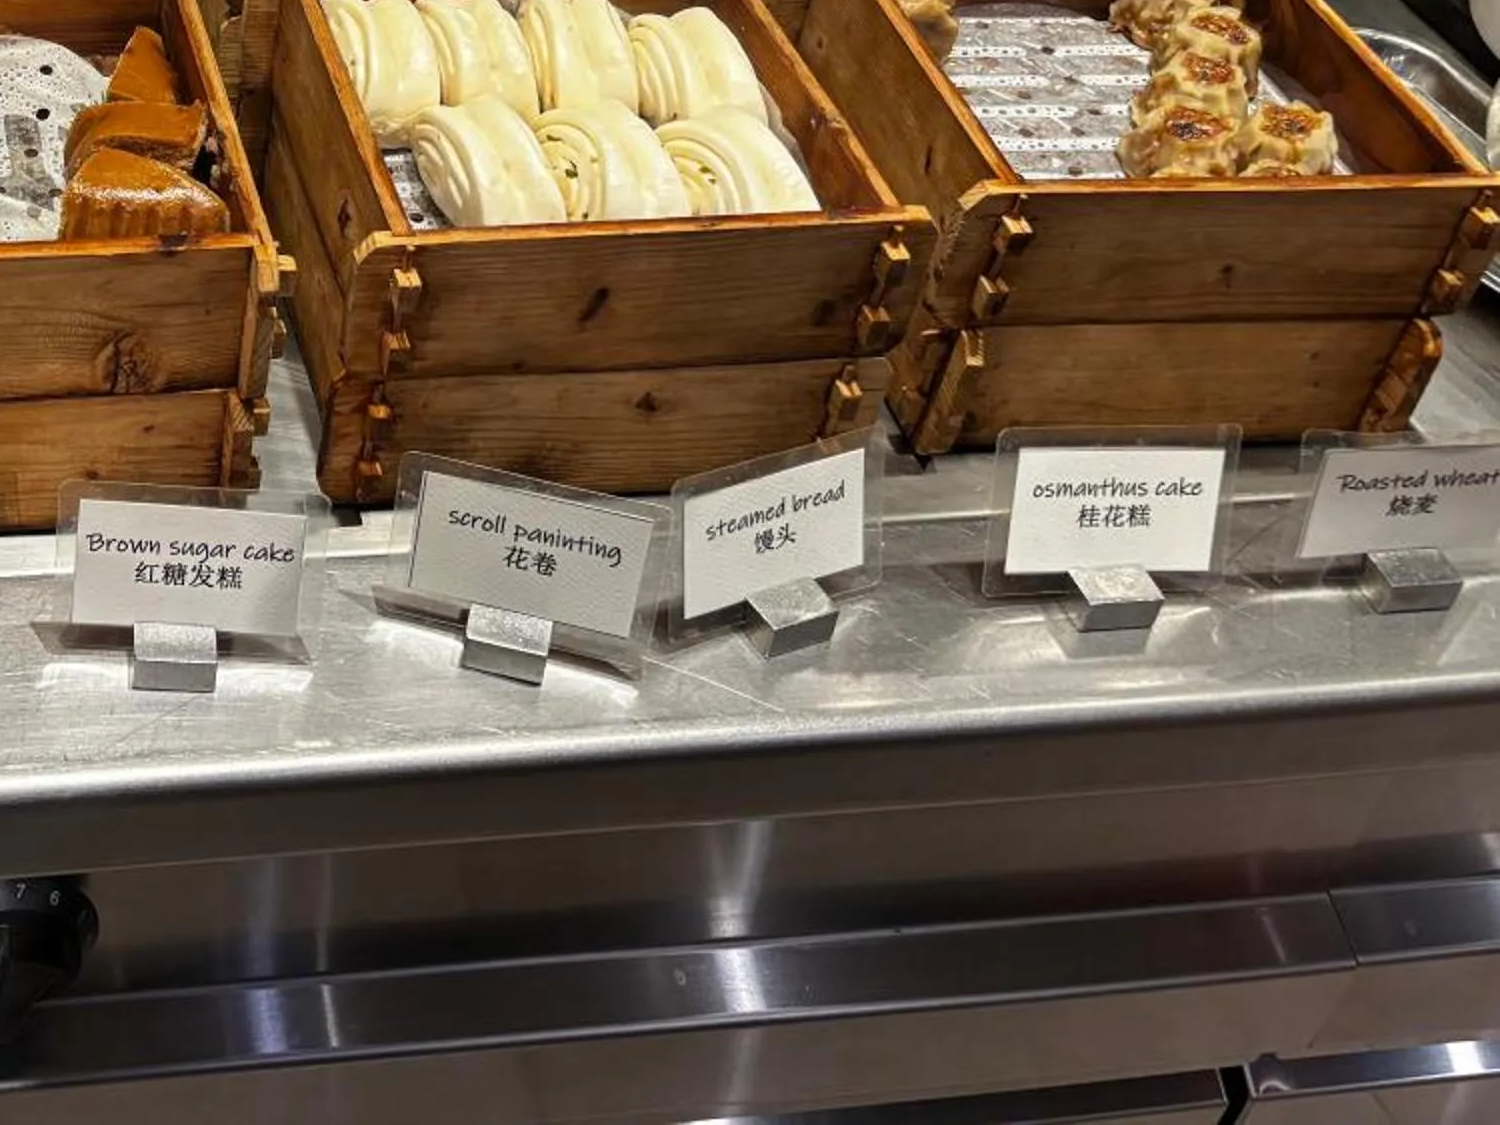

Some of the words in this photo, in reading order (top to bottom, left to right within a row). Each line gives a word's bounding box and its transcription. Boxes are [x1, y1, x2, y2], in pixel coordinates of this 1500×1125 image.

[1033, 477, 1149, 499] osmanthus
[1155, 477, 1203, 498] cake
[1337, 470, 1429, 493] Roasted
[706, 496, 785, 541] steamed
[792, 479, 845, 512] bread
[1077, 504, 1152, 530] 桂花糕
[86, 533, 161, 554] Brown
[169, 539, 237, 562] sugar
[243, 542, 295, 563] cake
[449, 510, 507, 535] scroll
[513, 524, 623, 568] paninting
[754, 523, 797, 554] 馒头
[134, 561, 243, 589] 红糖发糕
[503, 546, 557, 577] 花卷
[16, 883, 26, 899] 7
[49, 891, 61, 905] 6
